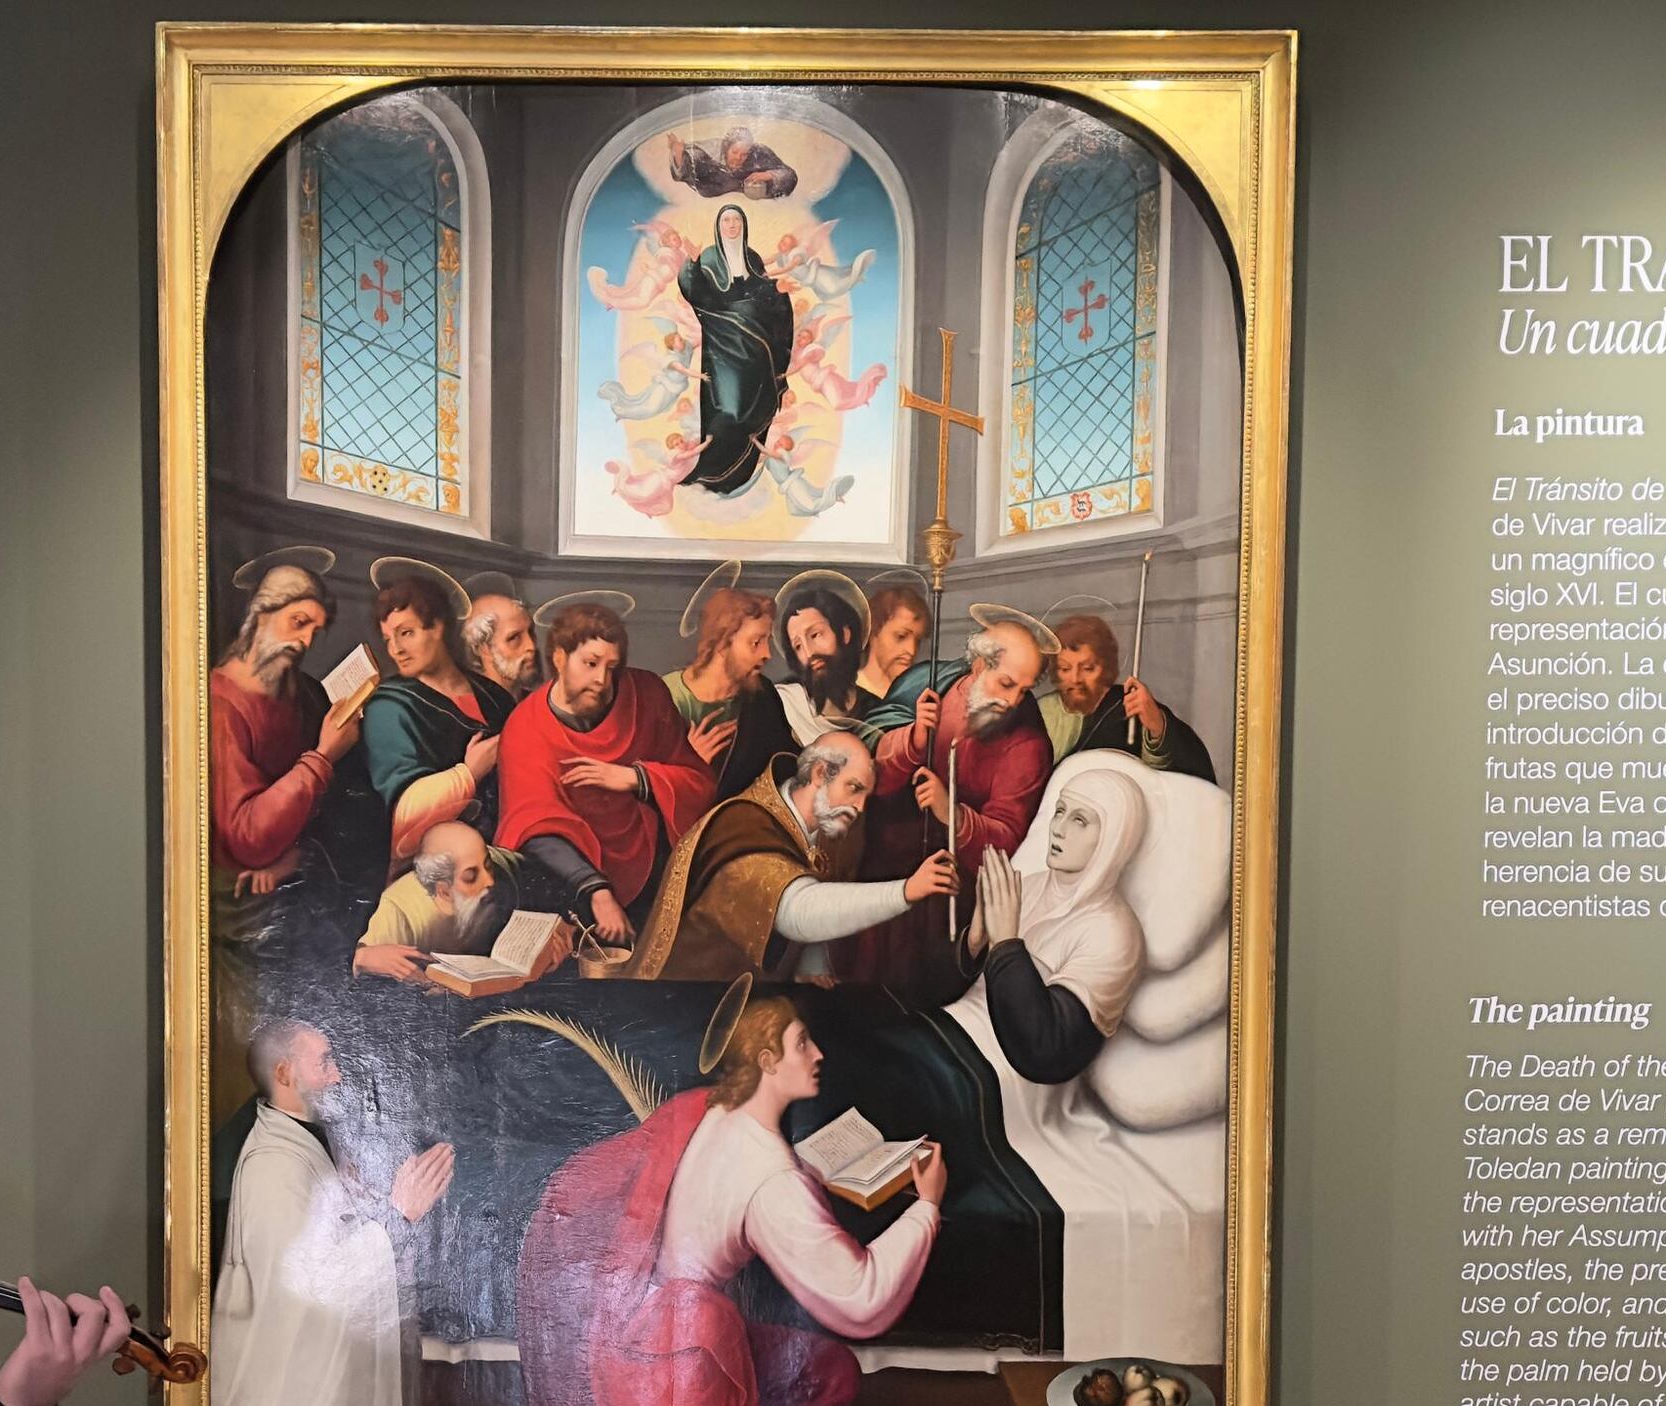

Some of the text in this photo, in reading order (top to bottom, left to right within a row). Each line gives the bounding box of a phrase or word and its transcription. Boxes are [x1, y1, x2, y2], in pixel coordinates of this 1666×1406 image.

[1498, 234, 1569, 293] EL
[1499, 308, 1557, 355] Un
[1494, 407, 1645, 444] La pintura
[1491, 476, 1518, 503] El
[1524, 476, 1624, 502] Tránsito
[1630, 476, 1665, 502] de
[1491, 512, 1525, 539] de
[1531, 511, 1597, 537] Vivar
[1491, 552, 1523, 572] un
[1530, 546, 1655, 577] magnífico
[1483, 858, 1592, 884] herencia
[1598, 859, 1632, 884] de
[1482, 893, 1651, 918] renacentistas
[1469, 995, 1653, 1031] The painting
[1466, 1054, 1513, 1079] The
[1519, 1054, 1596, 1079] Death
[1603, 1053, 1633, 1079] of
[1464, 1088, 1550, 1113] Correa
[1557, 1087, 1592, 1113] de
[1600, 1087, 1663, 1112] Vivar
[1462, 1121, 1549, 1147] stands
[1555, 1127, 1587, 1146] as
[1593, 1127, 1610, 1146] a
